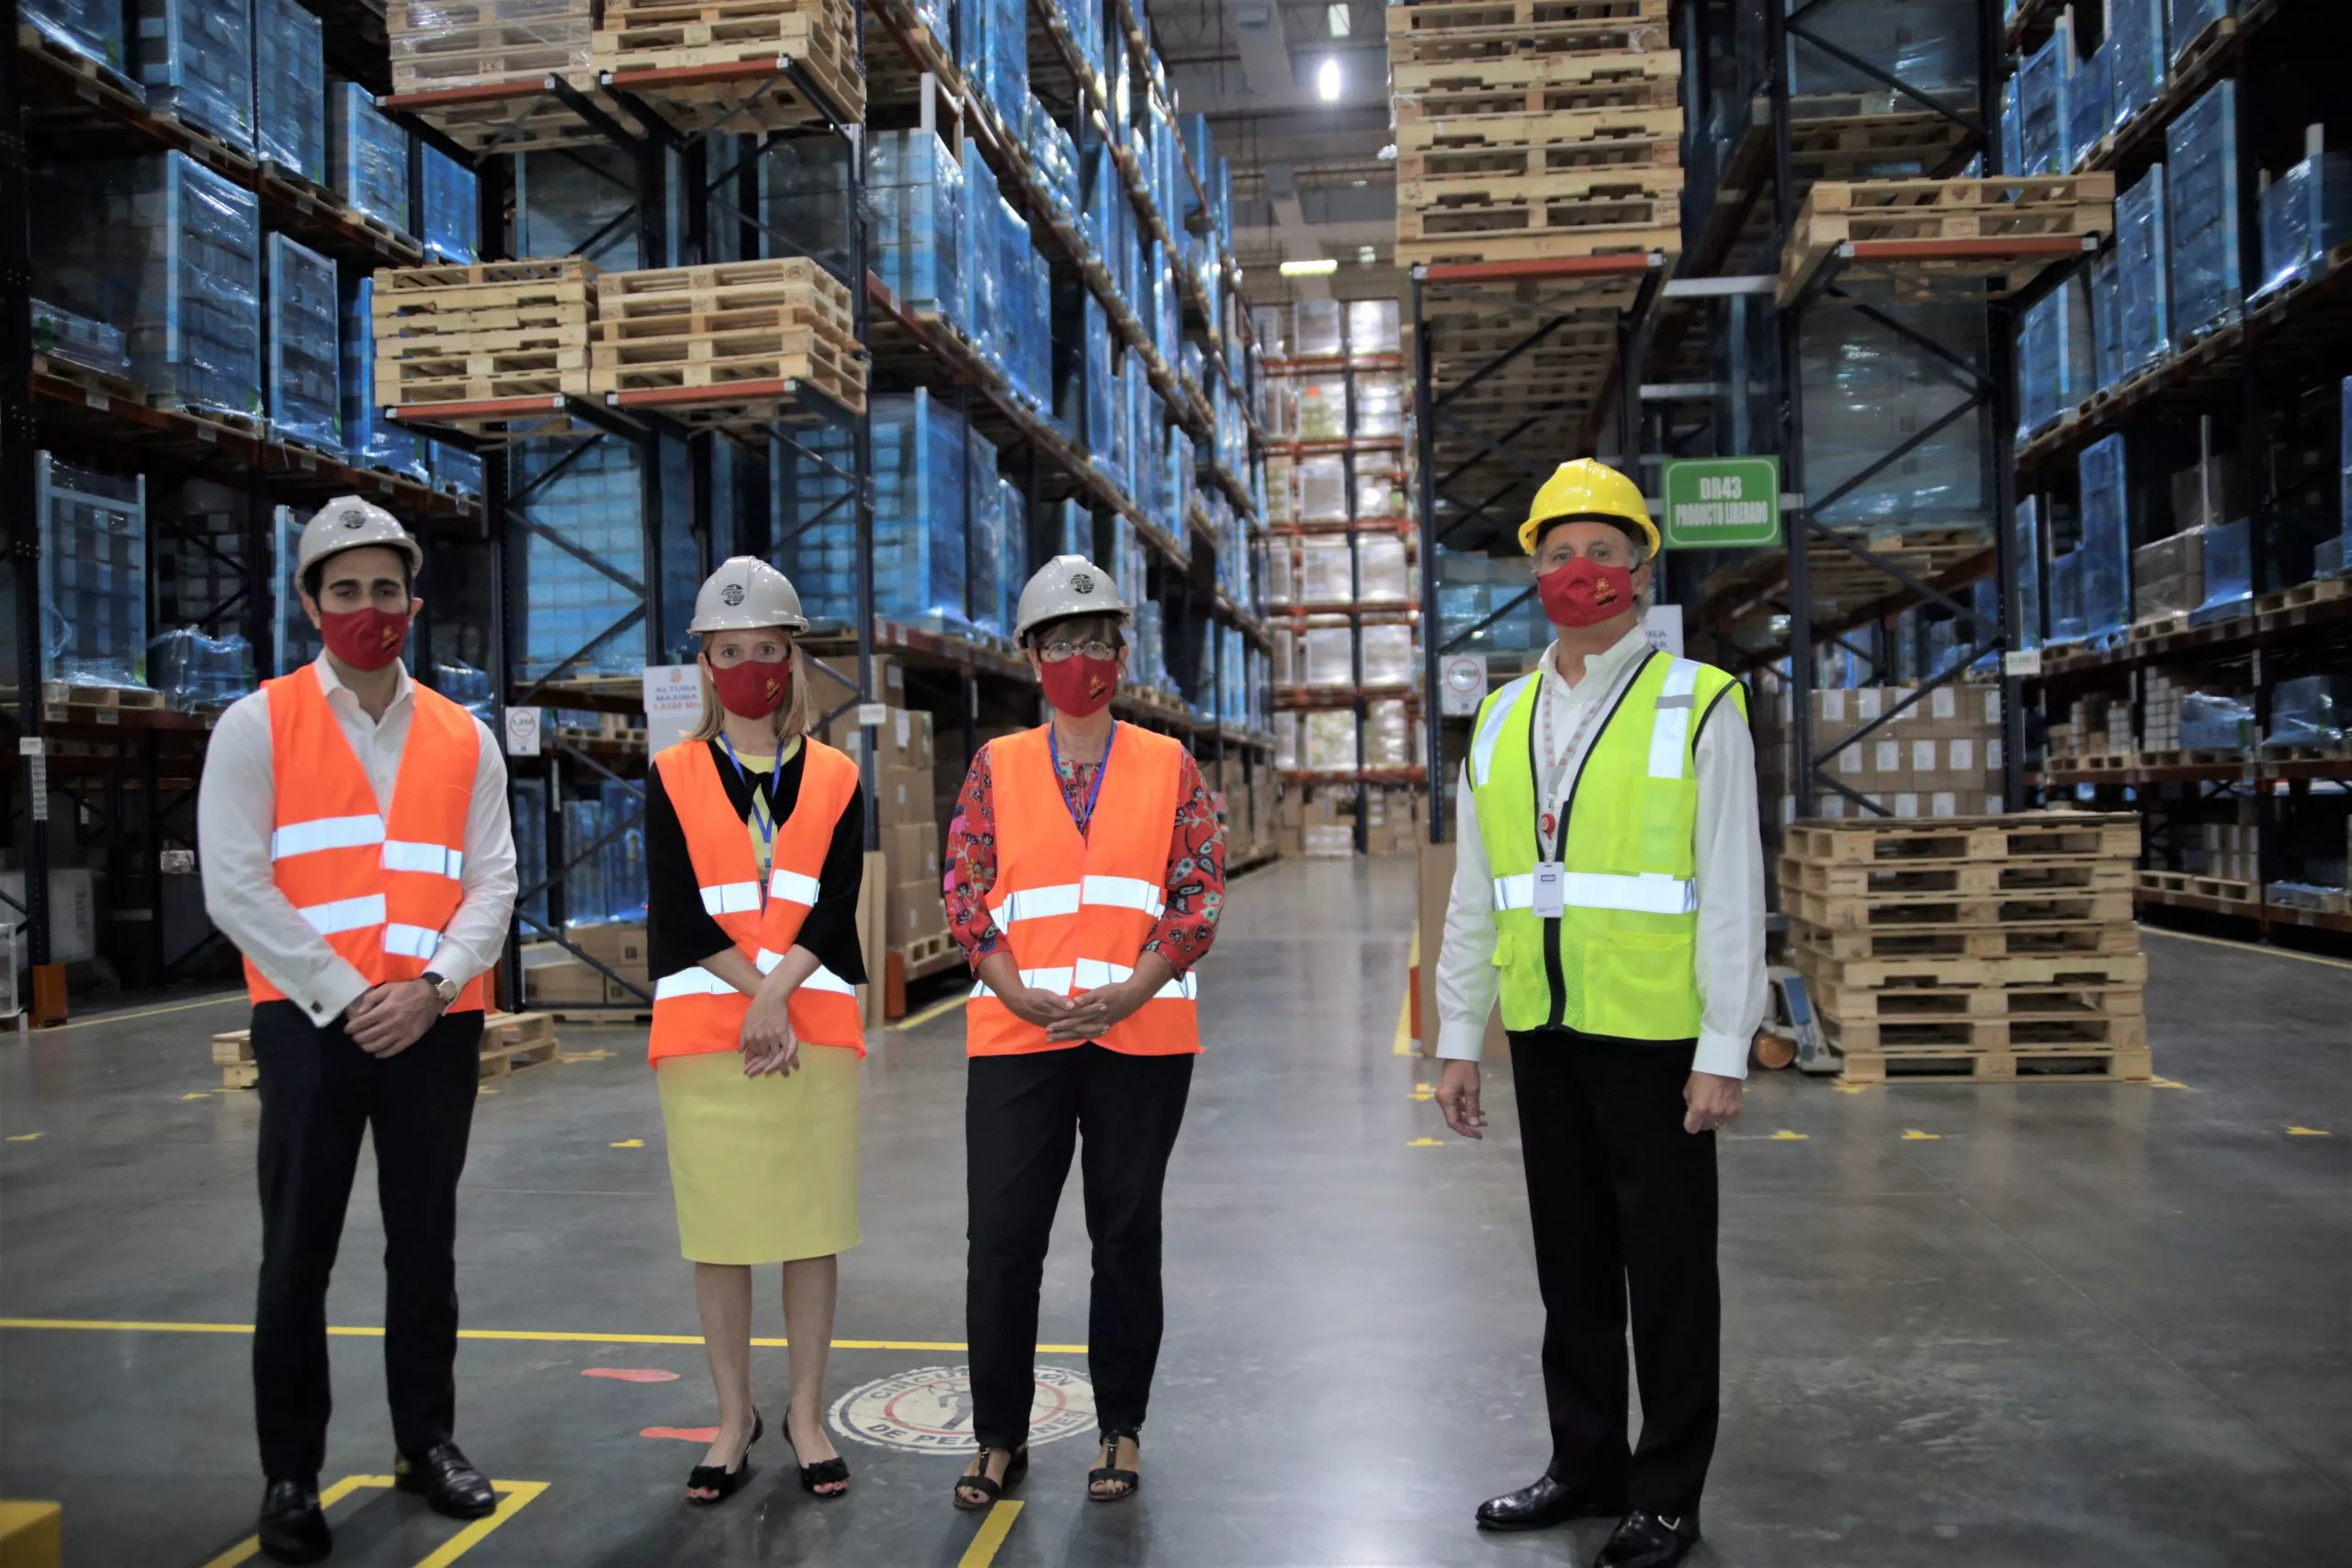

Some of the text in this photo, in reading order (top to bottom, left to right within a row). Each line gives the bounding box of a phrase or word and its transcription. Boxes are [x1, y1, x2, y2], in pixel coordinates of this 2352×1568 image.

[1700, 476, 1742, 500] DR43
[1675, 501, 1768, 526] PRODUCTO LIBERADO
[866, 1424, 908, 1438] DE
